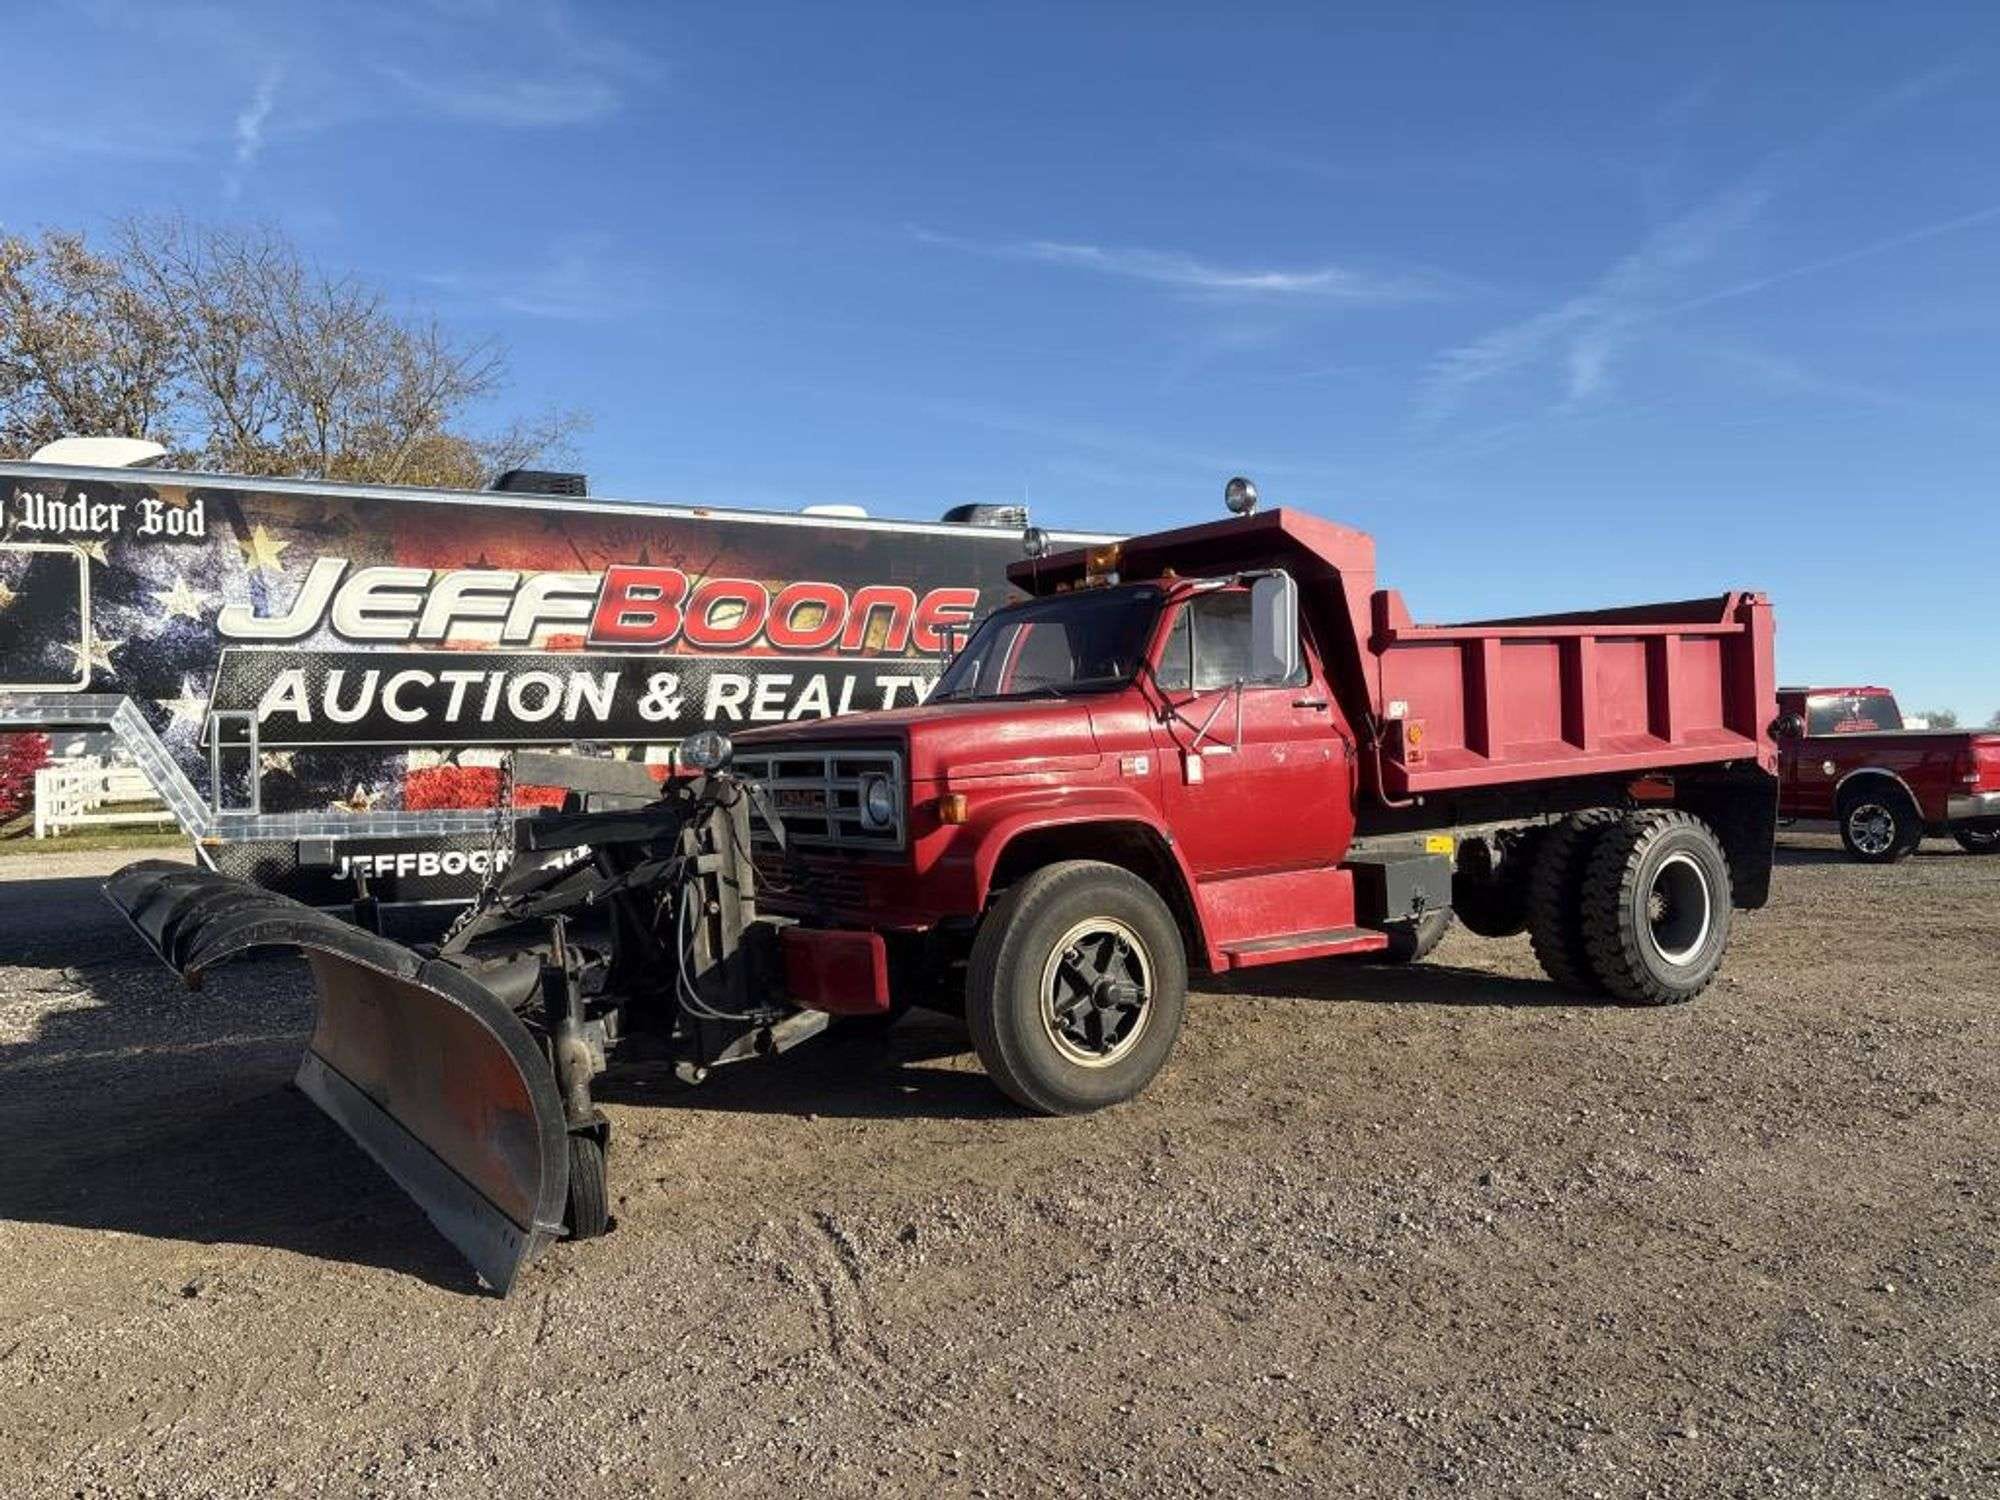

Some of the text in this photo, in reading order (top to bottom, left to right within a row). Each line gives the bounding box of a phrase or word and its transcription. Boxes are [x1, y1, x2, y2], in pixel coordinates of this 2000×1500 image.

[17, 492, 126, 534] Under
[135, 497, 206, 537] God
[258, 669, 941, 723] AUCTION & REALTY
